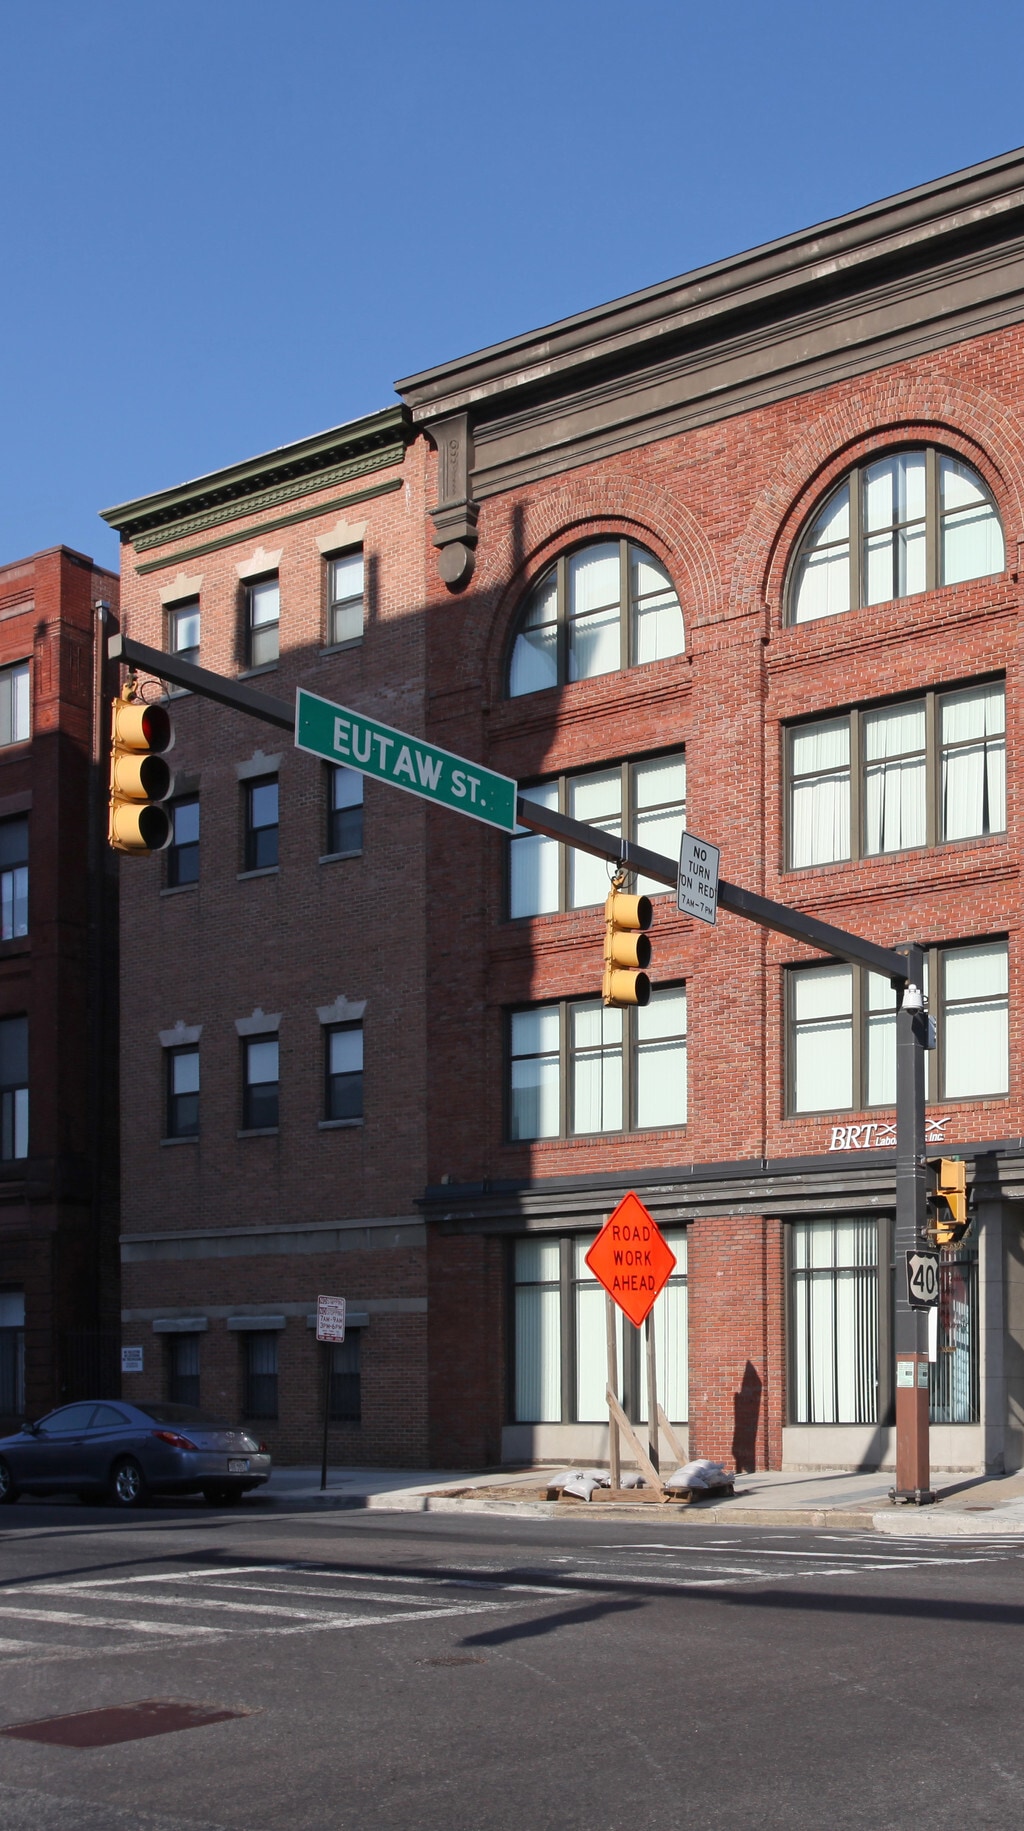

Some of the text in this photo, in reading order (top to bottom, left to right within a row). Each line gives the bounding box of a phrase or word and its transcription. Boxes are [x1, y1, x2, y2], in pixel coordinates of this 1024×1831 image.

[333, 716, 486, 807] EUTAW ST.
[693, 845, 707, 862] NO
[689, 860, 710, 881] TURN
[681, 874, 714, 899] ON RED
[828, 1123, 878, 1151] BRT
[929, 1132, 945, 1142] Inc.
[612, 1225, 651, 1241] ROAD
[613, 1250, 652, 1266] WORK
[612, 1275, 655, 1291] AHEAD
[913, 1264, 935, 1294] 40
